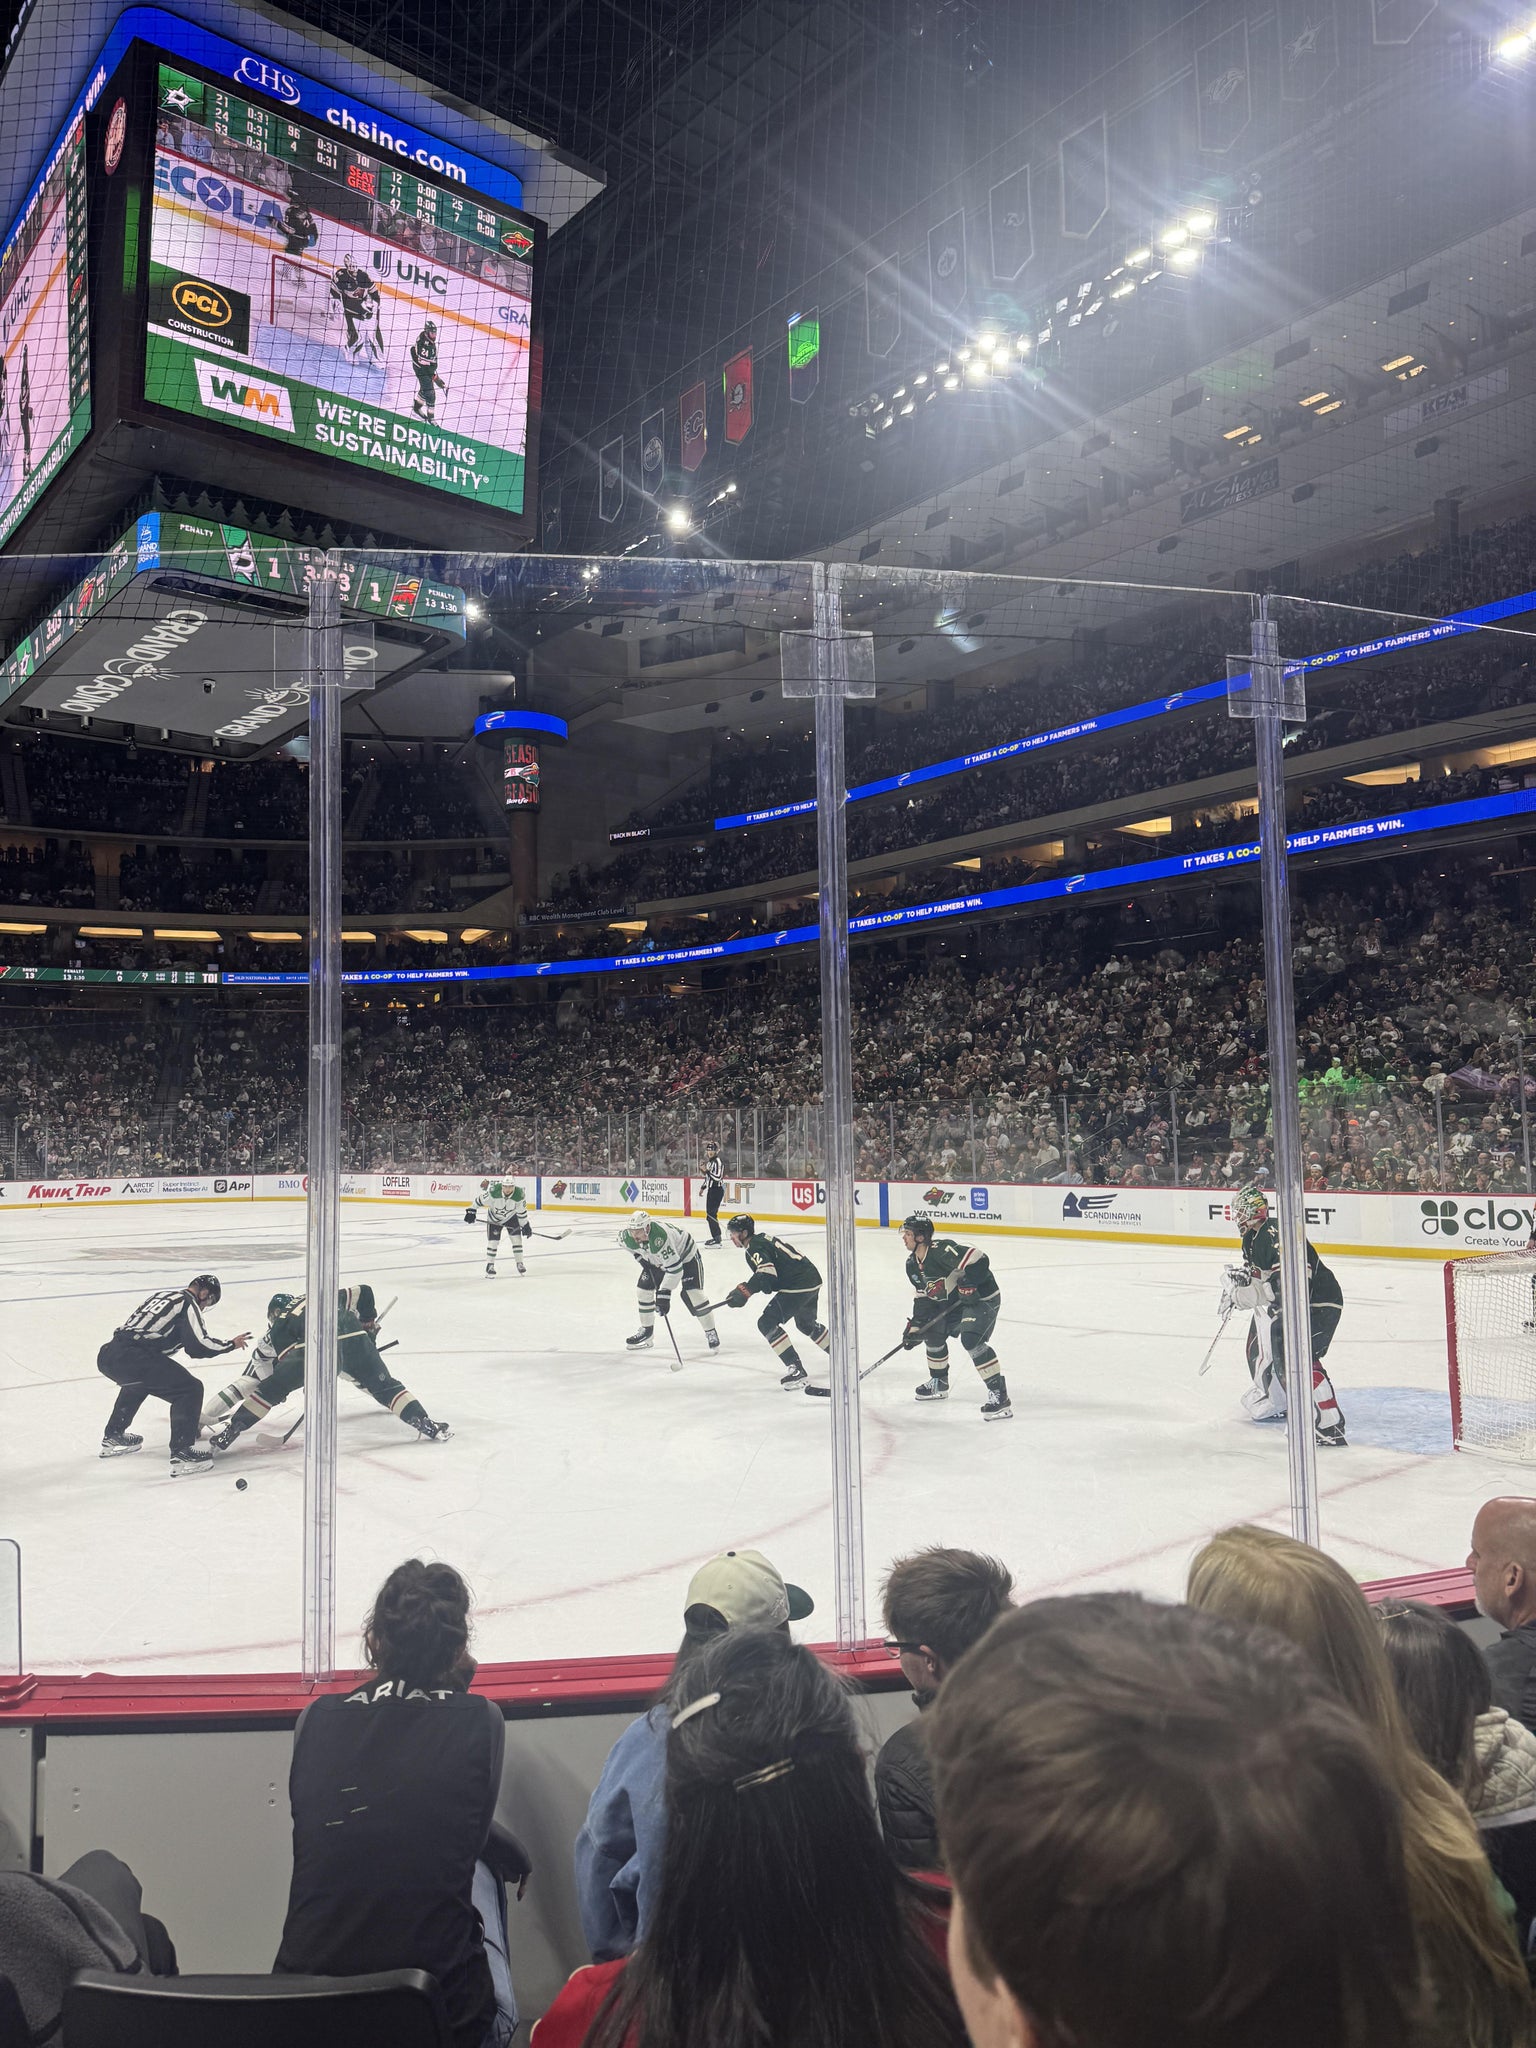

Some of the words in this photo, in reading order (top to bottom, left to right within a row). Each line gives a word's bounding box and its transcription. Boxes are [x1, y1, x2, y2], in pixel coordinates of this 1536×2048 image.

[238, 57, 297, 101] CHS
[216, 93, 228, 108] 21
[247, 107, 269, 126] 0:31
[215, 108, 229, 123] 24
[246, 121, 268, 140] 0:31
[214, 122, 228, 136] 53
[246, 135, 267, 153] 0:31
[287, 125, 301, 140] 96
[317, 138, 338, 156] 0:31
[326, 107, 467, 184] chsinc.com
[290, 141, 297, 152] 4
[316, 151, 337, 170] 0:31
[347, 175, 375, 197] GEEK
[349, 165, 376, 185] SEAT
[391, 171, 403, 185] 12
[417, 183, 437, 200] 0:00
[390, 184, 401, 197] 71
[416, 196, 436, 212] 0:00
[416, 210, 435, 226] 0:31
[452, 198, 464, 212] 25
[477, 210, 496, 226] 0:00
[454, 212, 460, 222] 7
[476, 222, 495, 238] 0:00
[396, 259, 448, 295] UHC
[181, 289, 223, 318] PCL
[498, 306, 530, 329] GRA
[167, 318, 234, 347] CONSTRUCTION
[210, 374, 281, 417] WM
[316, 397, 386, 436] WE'RE
[393, 424, 477, 466] DRIVING
[179, 523, 214, 538] PENALTY
[268, 557, 281, 579] 1
[298, 552, 310, 562] 15
[343, 562, 355, 573] 13
[370, 582, 381, 602] 1
[428, 588, 455, 601] PENALTY
[425, 598, 437, 608] 13
[440, 600, 458, 613] 1:30
[126, 609, 209, 662] GRAND
[1311, 653, 1340, 667] CO-OP
[1345, 649, 1358, 658] TO
[1359, 642, 1384, 655] HELP
[1385, 630, 1431, 648] FARMERS
[1432, 624, 1457, 637] WIN.
[60, 674, 133, 713] CASINO
[214, 704, 288, 737] GRAND
[964, 757, 971, 765] IT
[971, 752, 992, 763] TAKES
[1022, 740, 1032, 748] TO
[1031, 735, 1049, 746] HELP
[1049, 726, 1081, 740] FARMERS
[1184, 858, 1193, 868] IT
[1194, 852, 1226, 866] TAKES
[1227, 850, 1234, 859] A
[1236, 845, 1261, 858] CO-O
[1293, 834, 1321, 848] HELP
[1322, 824, 1375, 842] FARMERS
[1376, 819, 1405, 832] WIN.
[561, 909, 597, 920] Management
[597, 908, 610, 916] Club
[610, 906, 625, 915] Level
[856, 917, 876, 927] TAKES
[916, 907, 933, 917] HELP
[933, 901, 965, 913] FARMERS
[966, 897, 983, 907] WIN.
[622, 957, 640, 965] TAKES
[675, 951, 688, 959] HELP
[689, 948, 713, 957] FARMERS
[27, 1184, 73, 1199] KWIK
[75, 1183, 112, 1197] TRIP
[229, 1181, 251, 1192] App
[278, 1180, 300, 1189] BMO
[382, 1176, 410, 1188] LOFFLER
[641, 1179, 668, 1194] Regions
[641, 1191, 670, 1206] Hospital
[794, 1187, 813, 1204] us
[913, 1209, 1002, 1221] WATCH.WILD.COM
[1083, 1210, 1142, 1221] SCANDINAVIAN
[661, 1246, 676, 1261] 24
[1464, 1236, 1500, 1247] Create
[1504, 1236, 1527, 1248] Your
[141, 1298, 170, 1315] 88
[343, 1679, 454, 1705] ARIAT
